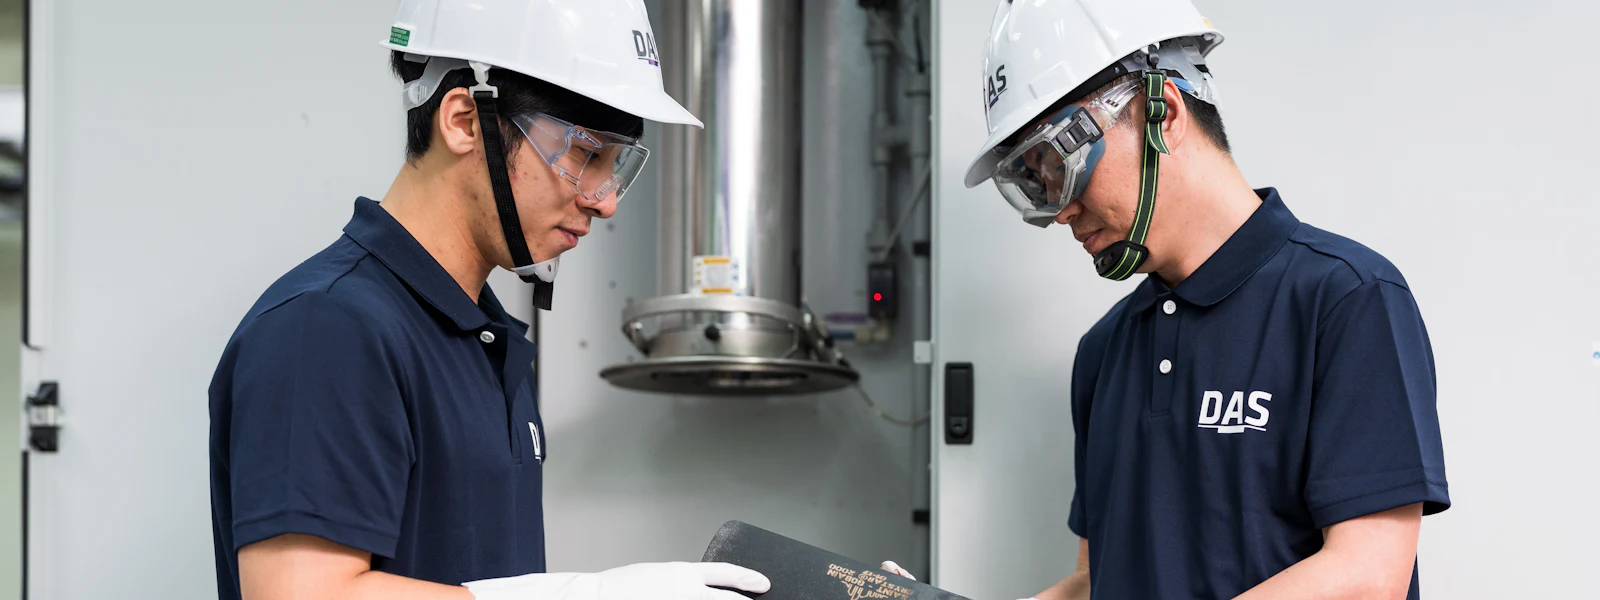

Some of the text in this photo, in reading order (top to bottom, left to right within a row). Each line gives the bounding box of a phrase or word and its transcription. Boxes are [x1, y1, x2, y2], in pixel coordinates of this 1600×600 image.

[631, 29, 658, 60] DA
[986, 64, 1006, 105] AS
[1198, 390, 1273, 427] DAS
[826, 568, 866, 587] GOBAIN
[828, 563, 857, 576] 2000
[876, 585, 909, 600] SAINT
